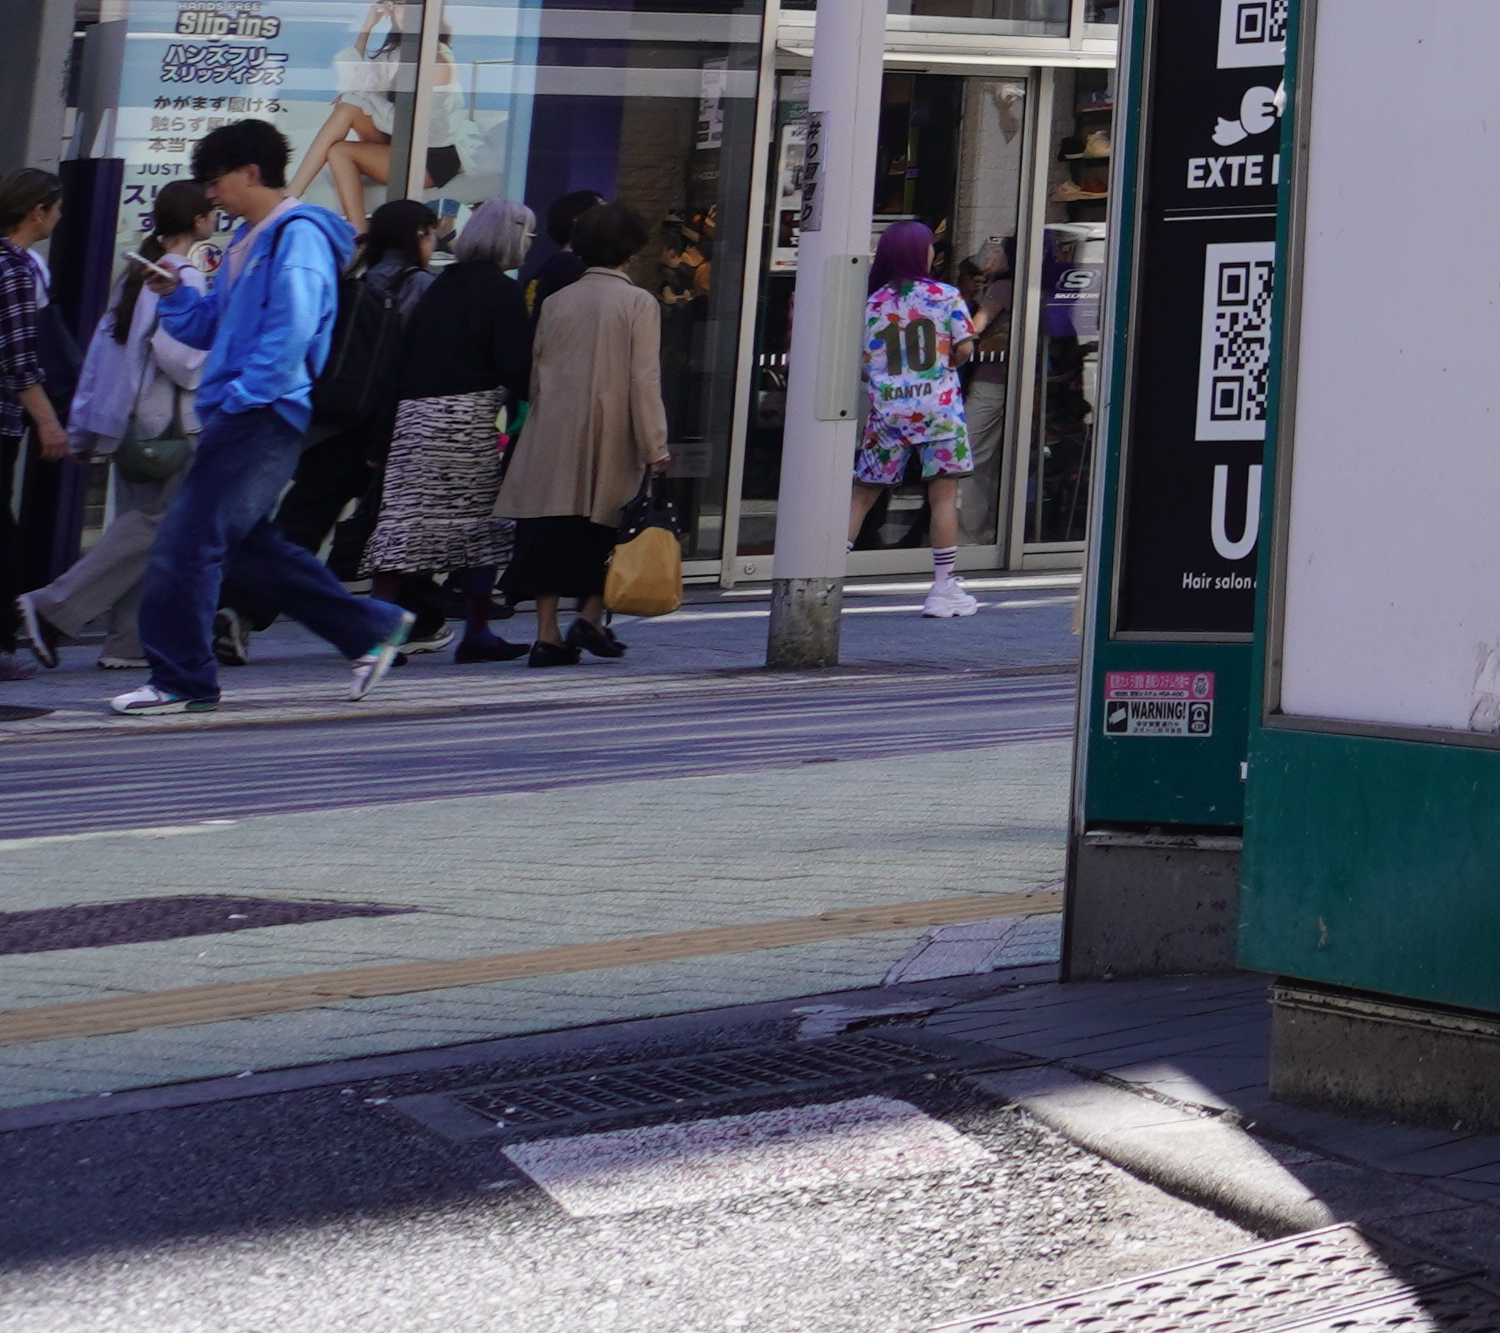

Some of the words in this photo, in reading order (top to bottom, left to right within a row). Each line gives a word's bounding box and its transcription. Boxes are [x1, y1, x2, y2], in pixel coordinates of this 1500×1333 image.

[175, 10, 281, 40] Slip-ins
[164, 44, 288, 64] ハンズフリー
[160, 63, 285, 85] スリップインズ
[153, 96, 290, 114] かがまず履ける、
[137, 163, 183, 176] JUST
[1186, 155, 1264, 189] EXTE
[874, 318, 937, 377] 10
[884, 382, 933, 402] KANYA
[1182, 572, 1213, 590] Hair
[1214, 572, 1251, 591] salon
[1131, 701, 1187, 721] WARNING!
